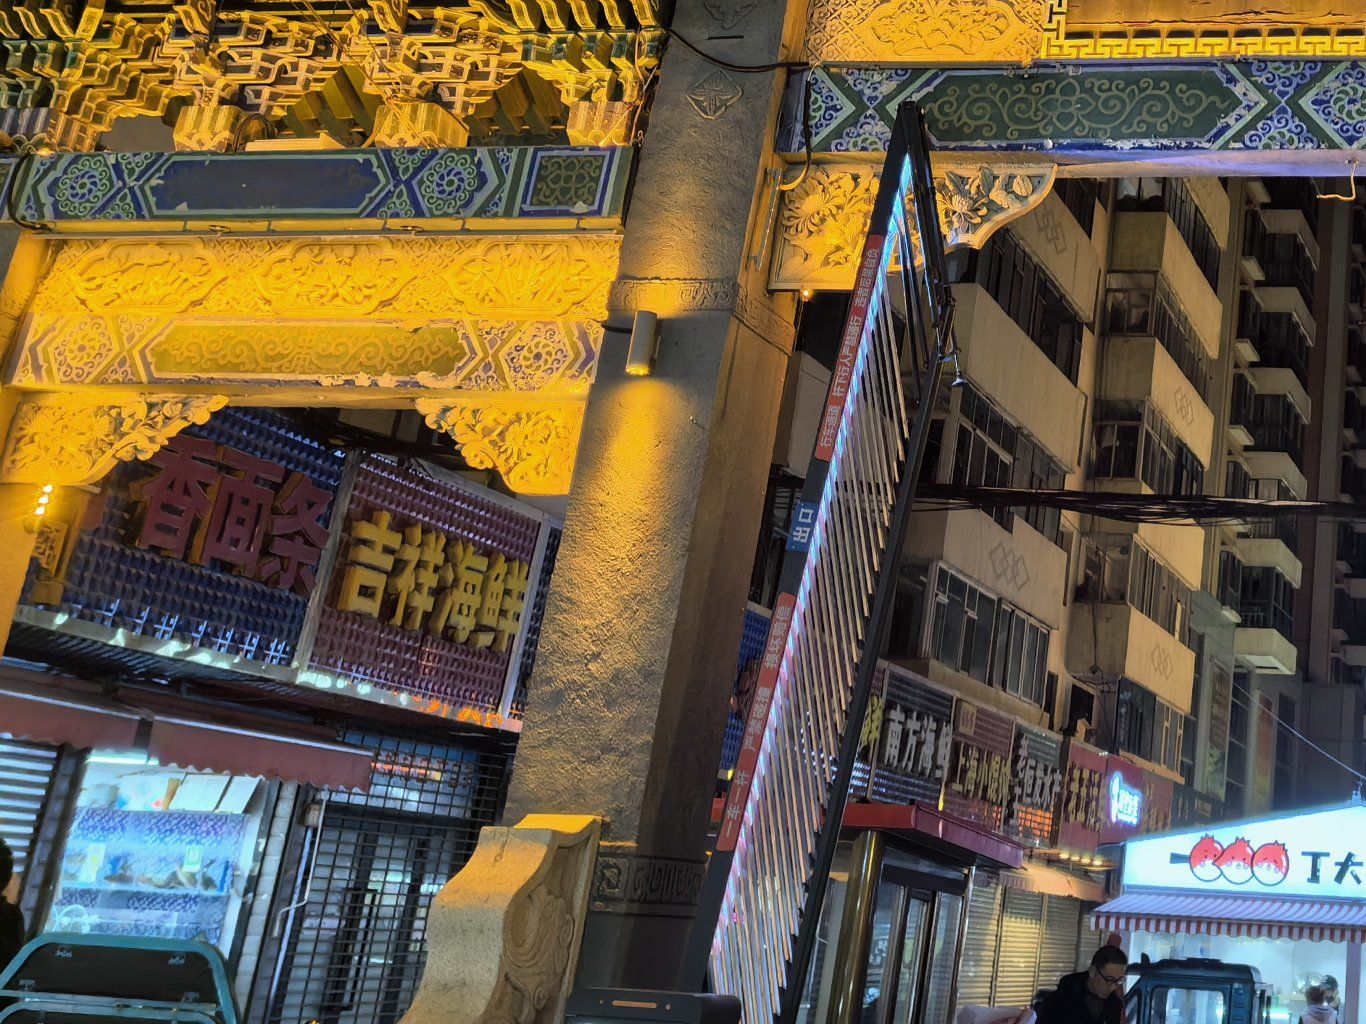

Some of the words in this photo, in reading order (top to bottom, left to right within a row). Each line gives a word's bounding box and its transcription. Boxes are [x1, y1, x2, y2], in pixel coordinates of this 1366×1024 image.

[792, 507, 815, 544] 出口
[340, 510, 528, 653] 吉祥海鲜
[725, 770, 749, 838] 一车一杆
